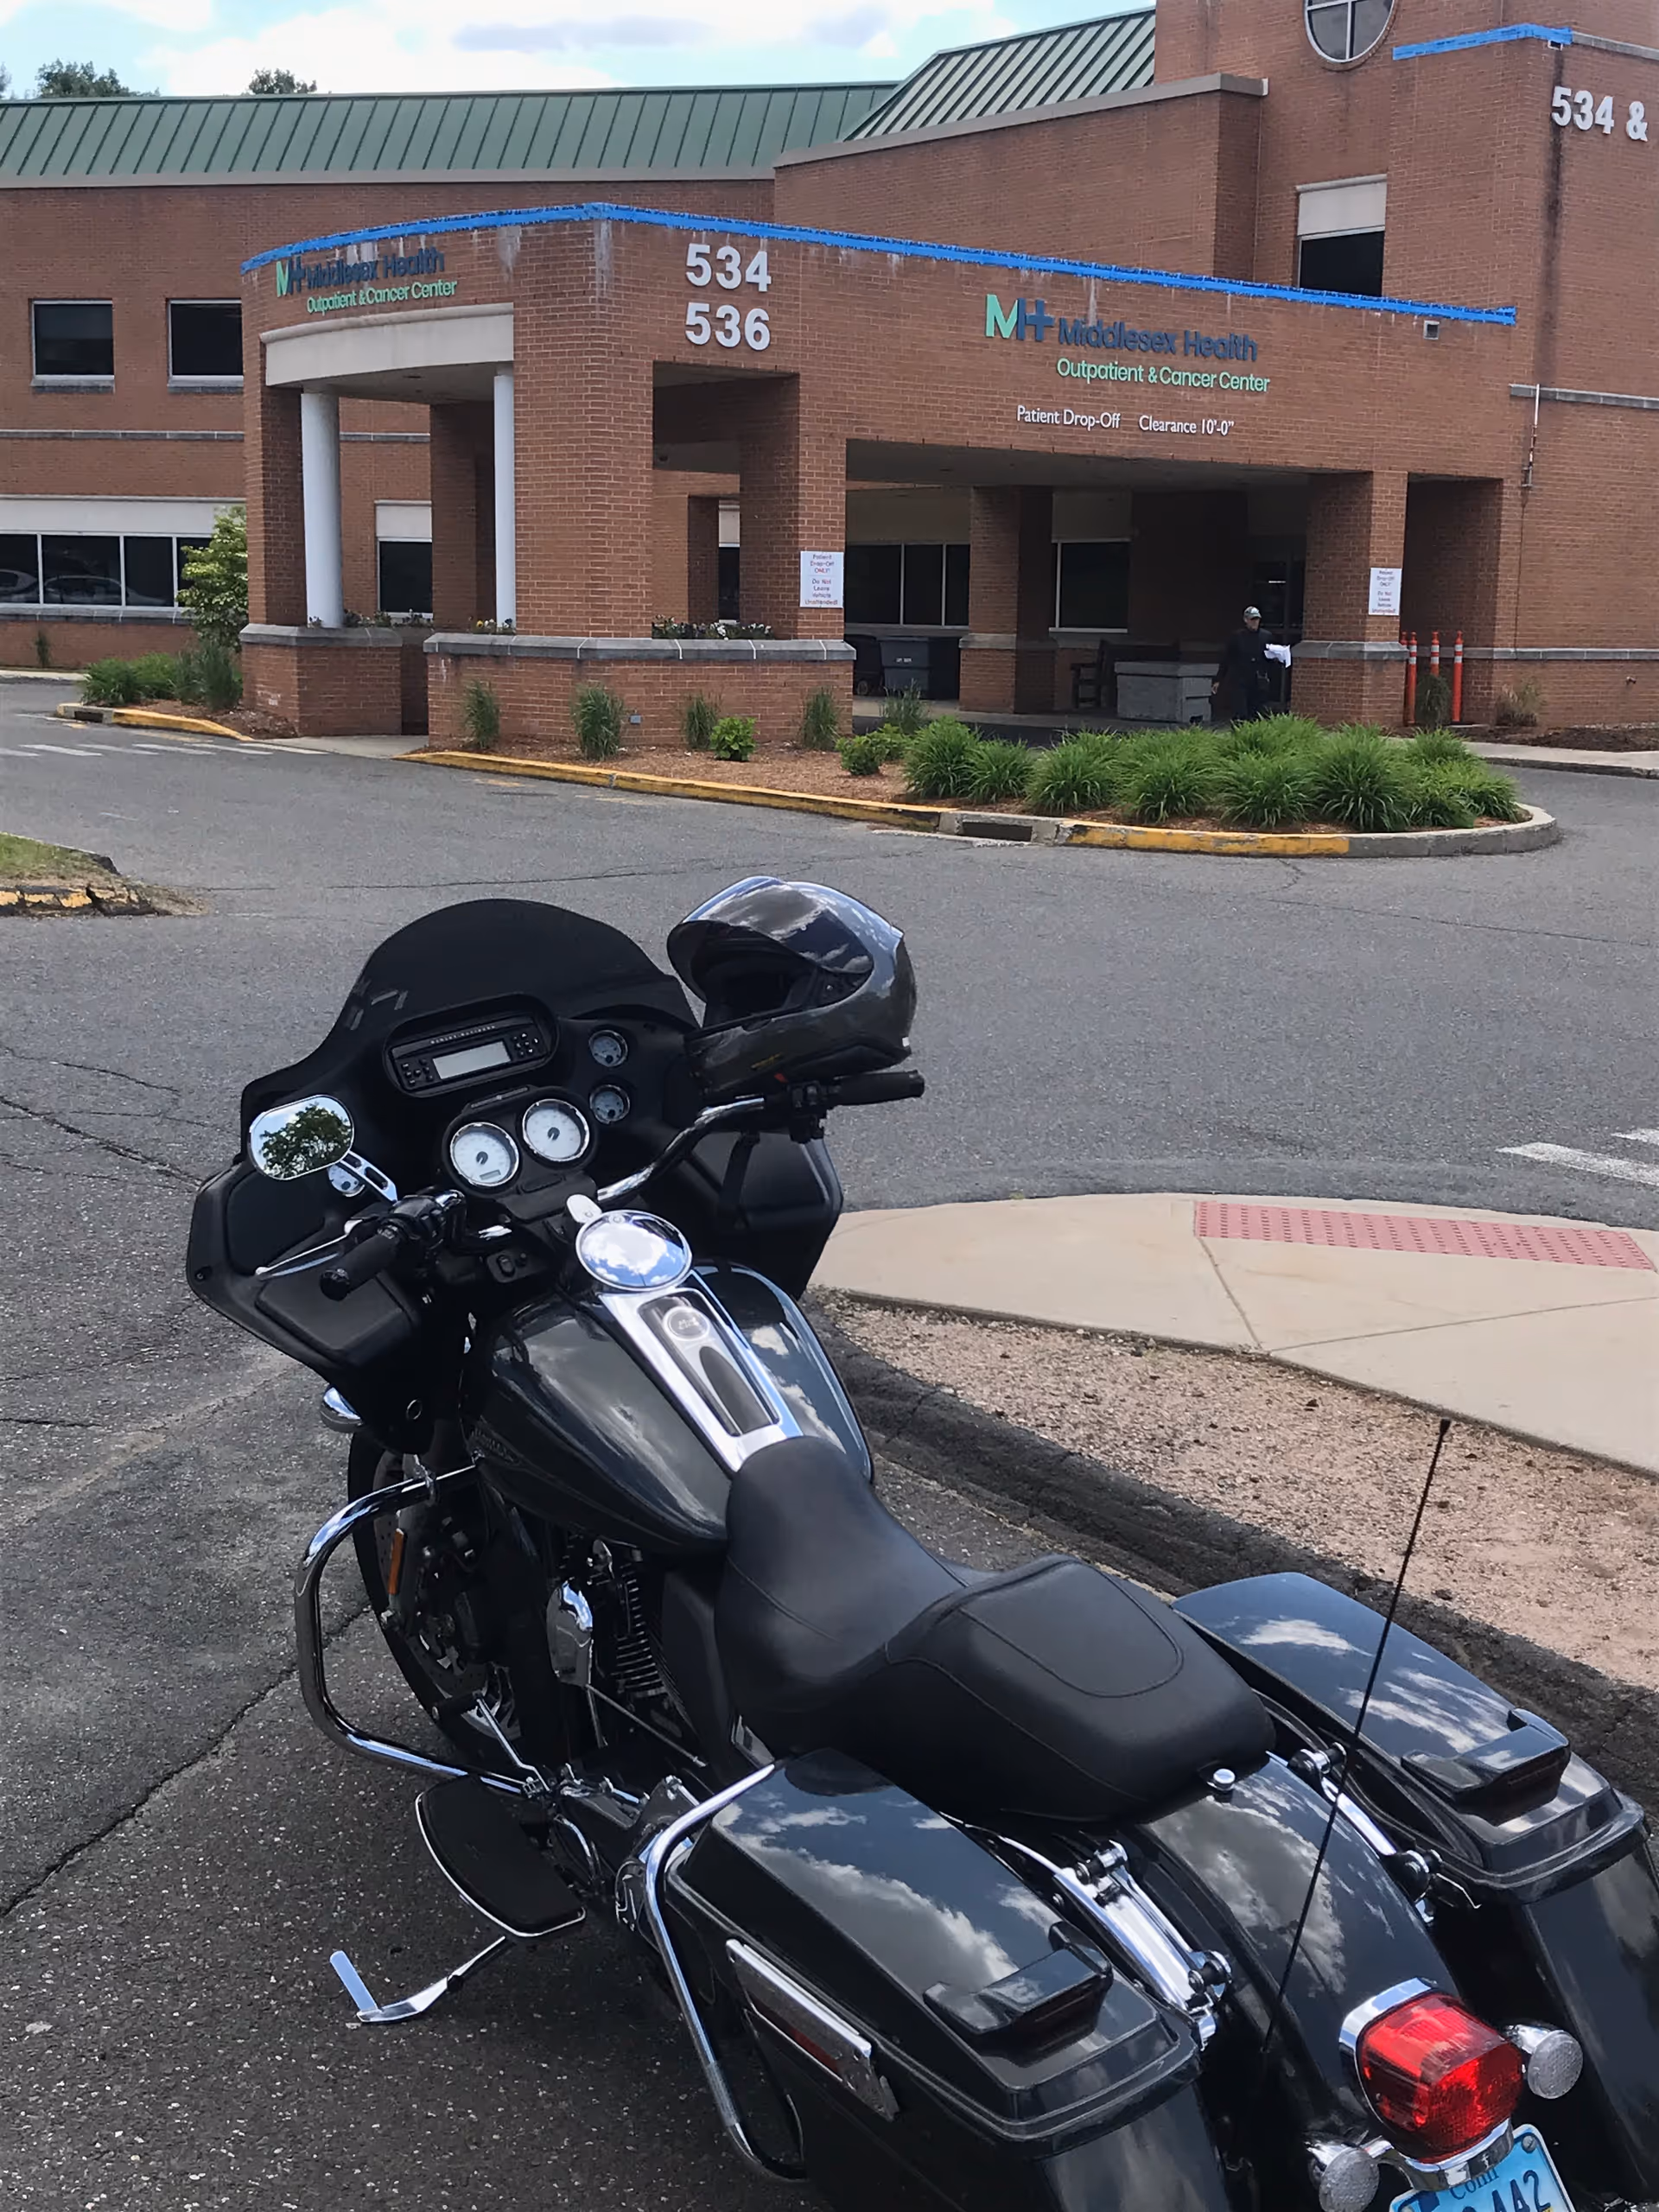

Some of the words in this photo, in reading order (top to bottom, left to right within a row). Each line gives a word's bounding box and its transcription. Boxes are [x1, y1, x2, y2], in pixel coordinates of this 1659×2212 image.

[1552, 86, 1615, 135] 534
[1626, 100, 1649, 143] &
[306, 258, 378, 289] Middlesex
[383, 246, 445, 278] Health
[685, 242, 772, 293] 534
[307, 290, 357, 316] Outpatient
[359, 292, 367, 306] &
[365, 286, 410, 304] Cancer
[410, 278, 458, 300] Center
[684, 302, 771, 351] 536
[1058, 317, 1177, 356] Middlesex
[1183, 329, 1259, 362] Health
[1057, 357, 1144, 385] Outpatient
[1147, 366, 1159, 383] &
[1159, 365, 1217, 389] Cancer
[1218, 371, 1271, 393] Center
[1017, 404, 1061, 426] Patient
[1063, 409, 1122, 431] Drop-Off
[1139, 414, 1198, 435] Clearance
